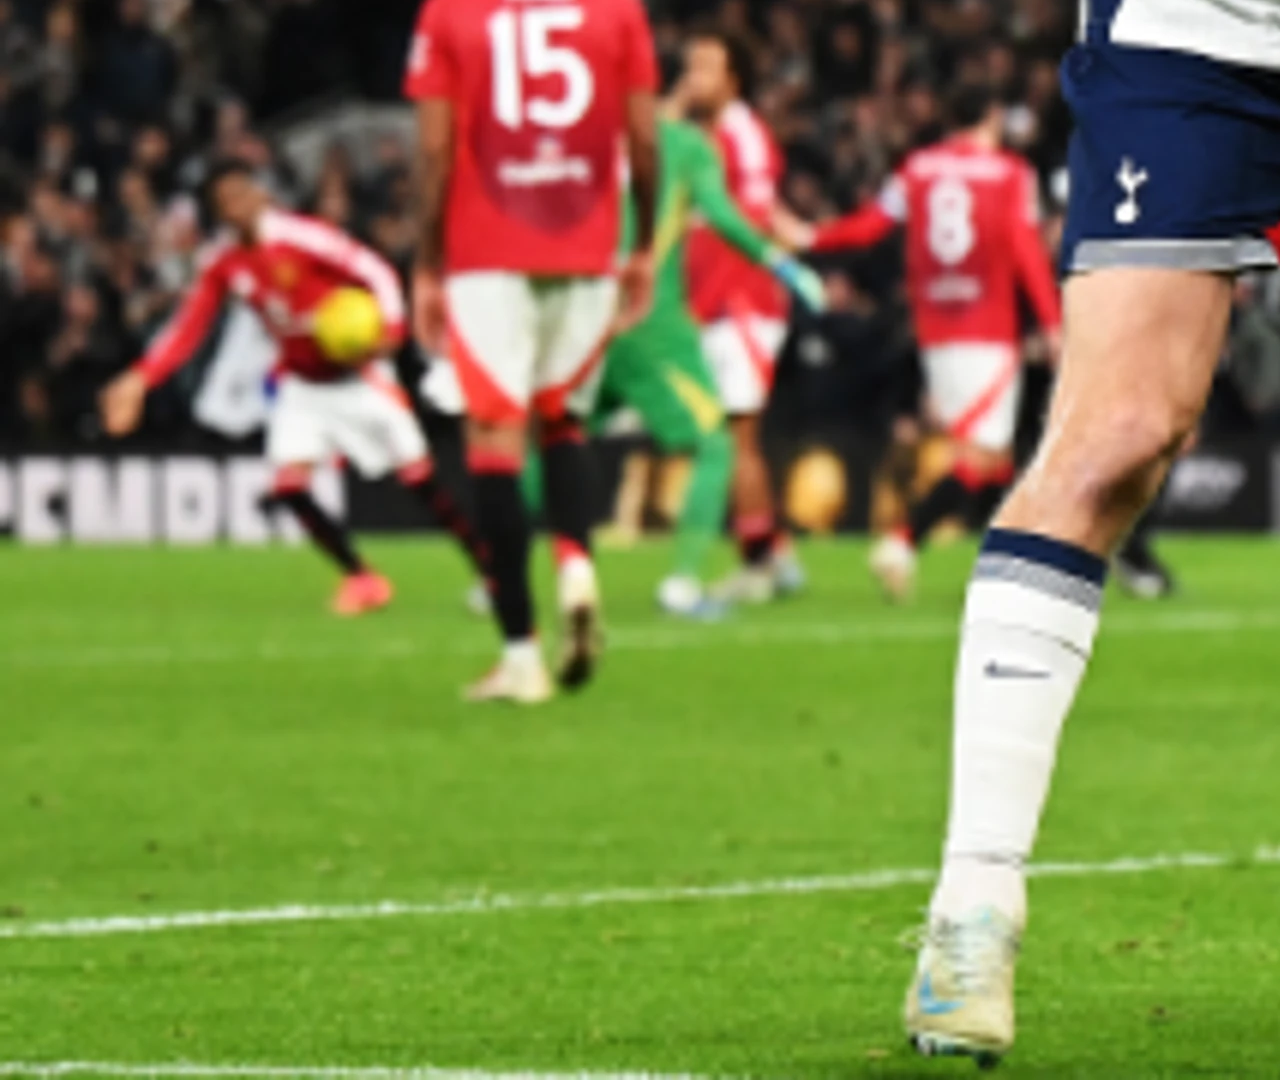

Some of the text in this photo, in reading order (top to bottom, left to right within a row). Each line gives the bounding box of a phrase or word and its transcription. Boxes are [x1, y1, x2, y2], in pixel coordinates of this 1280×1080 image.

[486, 7, 595, 131] 15
[926, 178, 976, 265] 8
[0, 455, 345, 542] EMBER
